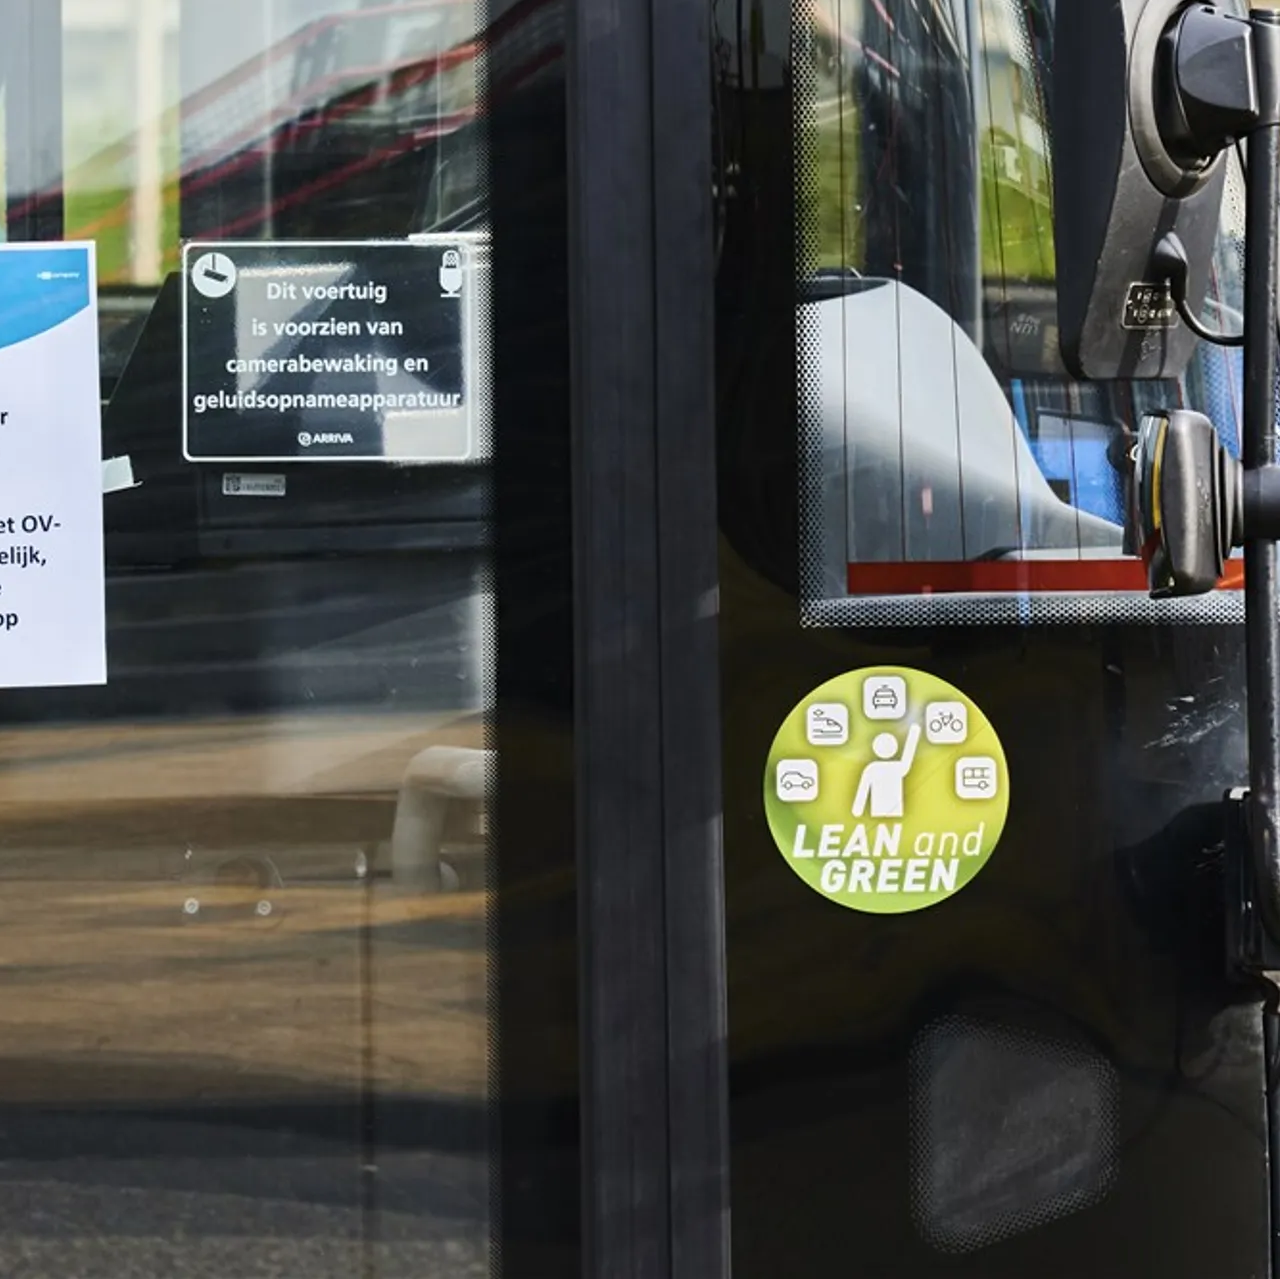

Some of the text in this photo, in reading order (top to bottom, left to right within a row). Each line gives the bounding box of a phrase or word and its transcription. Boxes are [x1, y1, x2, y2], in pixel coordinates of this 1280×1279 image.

[266, 280, 387, 304] Dit voertuig
[251, 317, 403, 337] is voorzien van
[225, 353, 429, 377] camerabewaking en
[193, 389, 462, 414] geluidsopnameapparatuur
[312, 432, 354, 444] ARRIVA
[21, 514, 61, 533] OV-
[792, 821, 986, 858] LEAN and
[820, 857, 960, 893] GREEN
